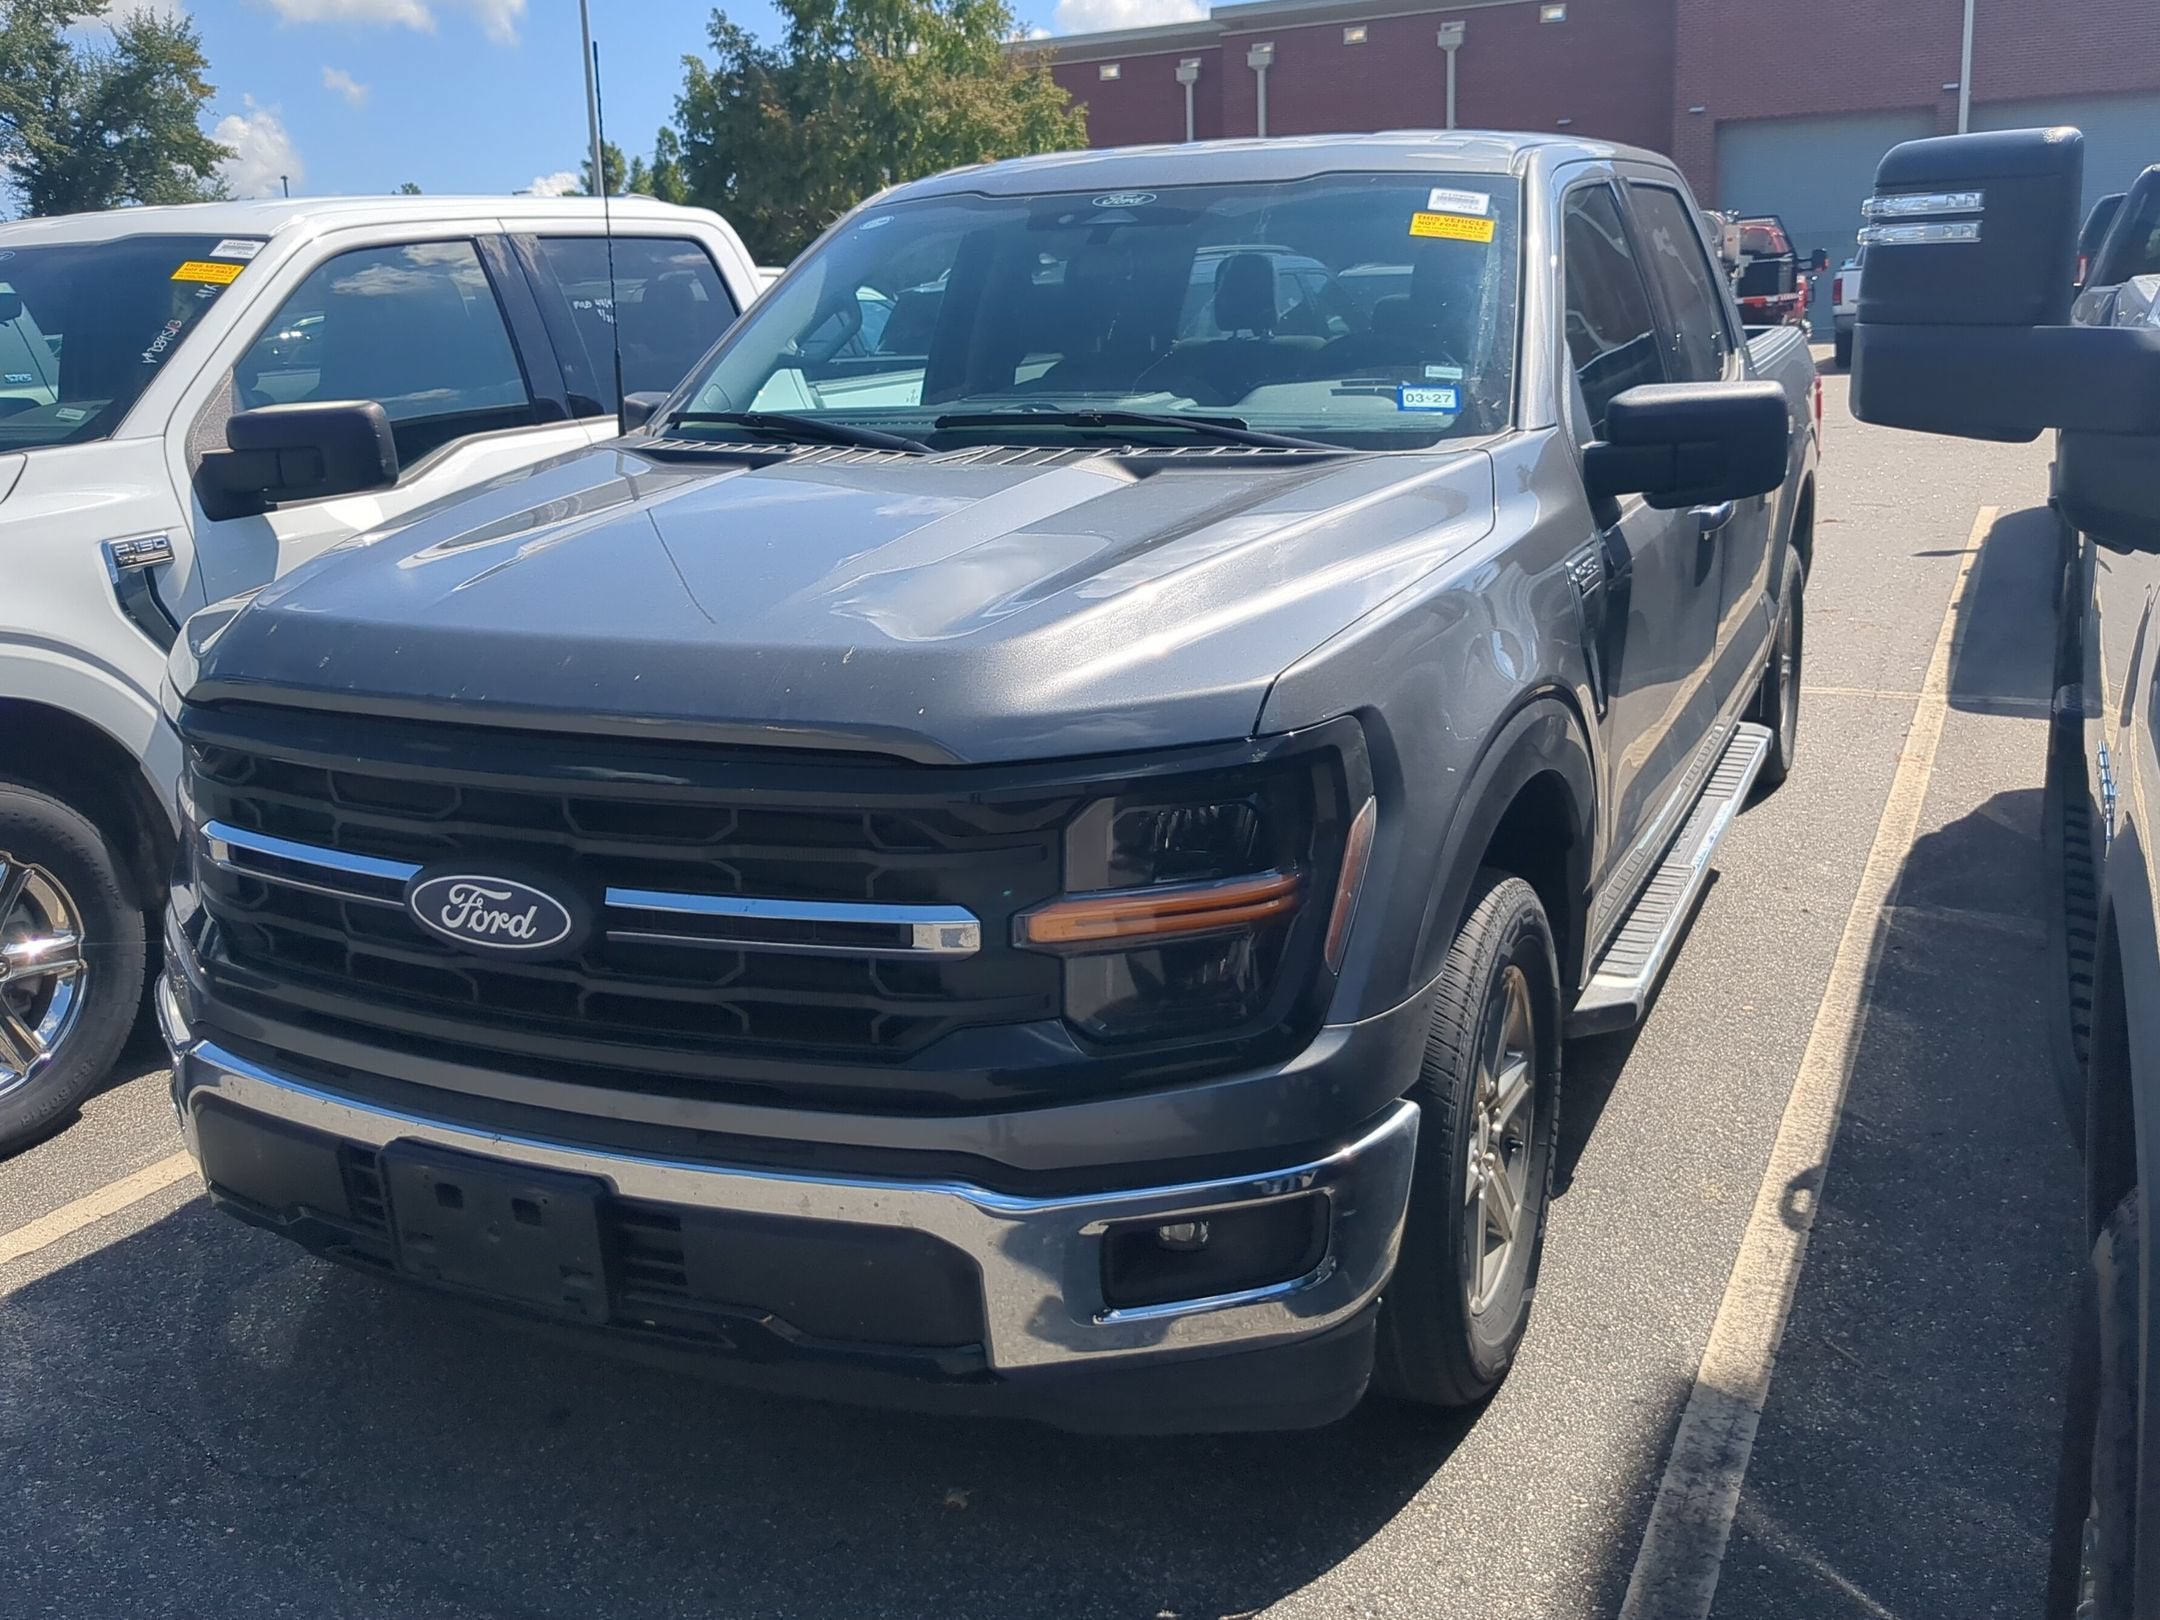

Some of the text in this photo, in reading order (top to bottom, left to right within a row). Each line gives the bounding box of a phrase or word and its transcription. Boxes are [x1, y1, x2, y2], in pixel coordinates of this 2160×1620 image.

[1417, 214, 1489, 227] THIS VEHICLE
[1405, 393, 1452, 403] 03 27
[114, 537, 167, 556] F-150
[441, 883, 538, 939] Ford
